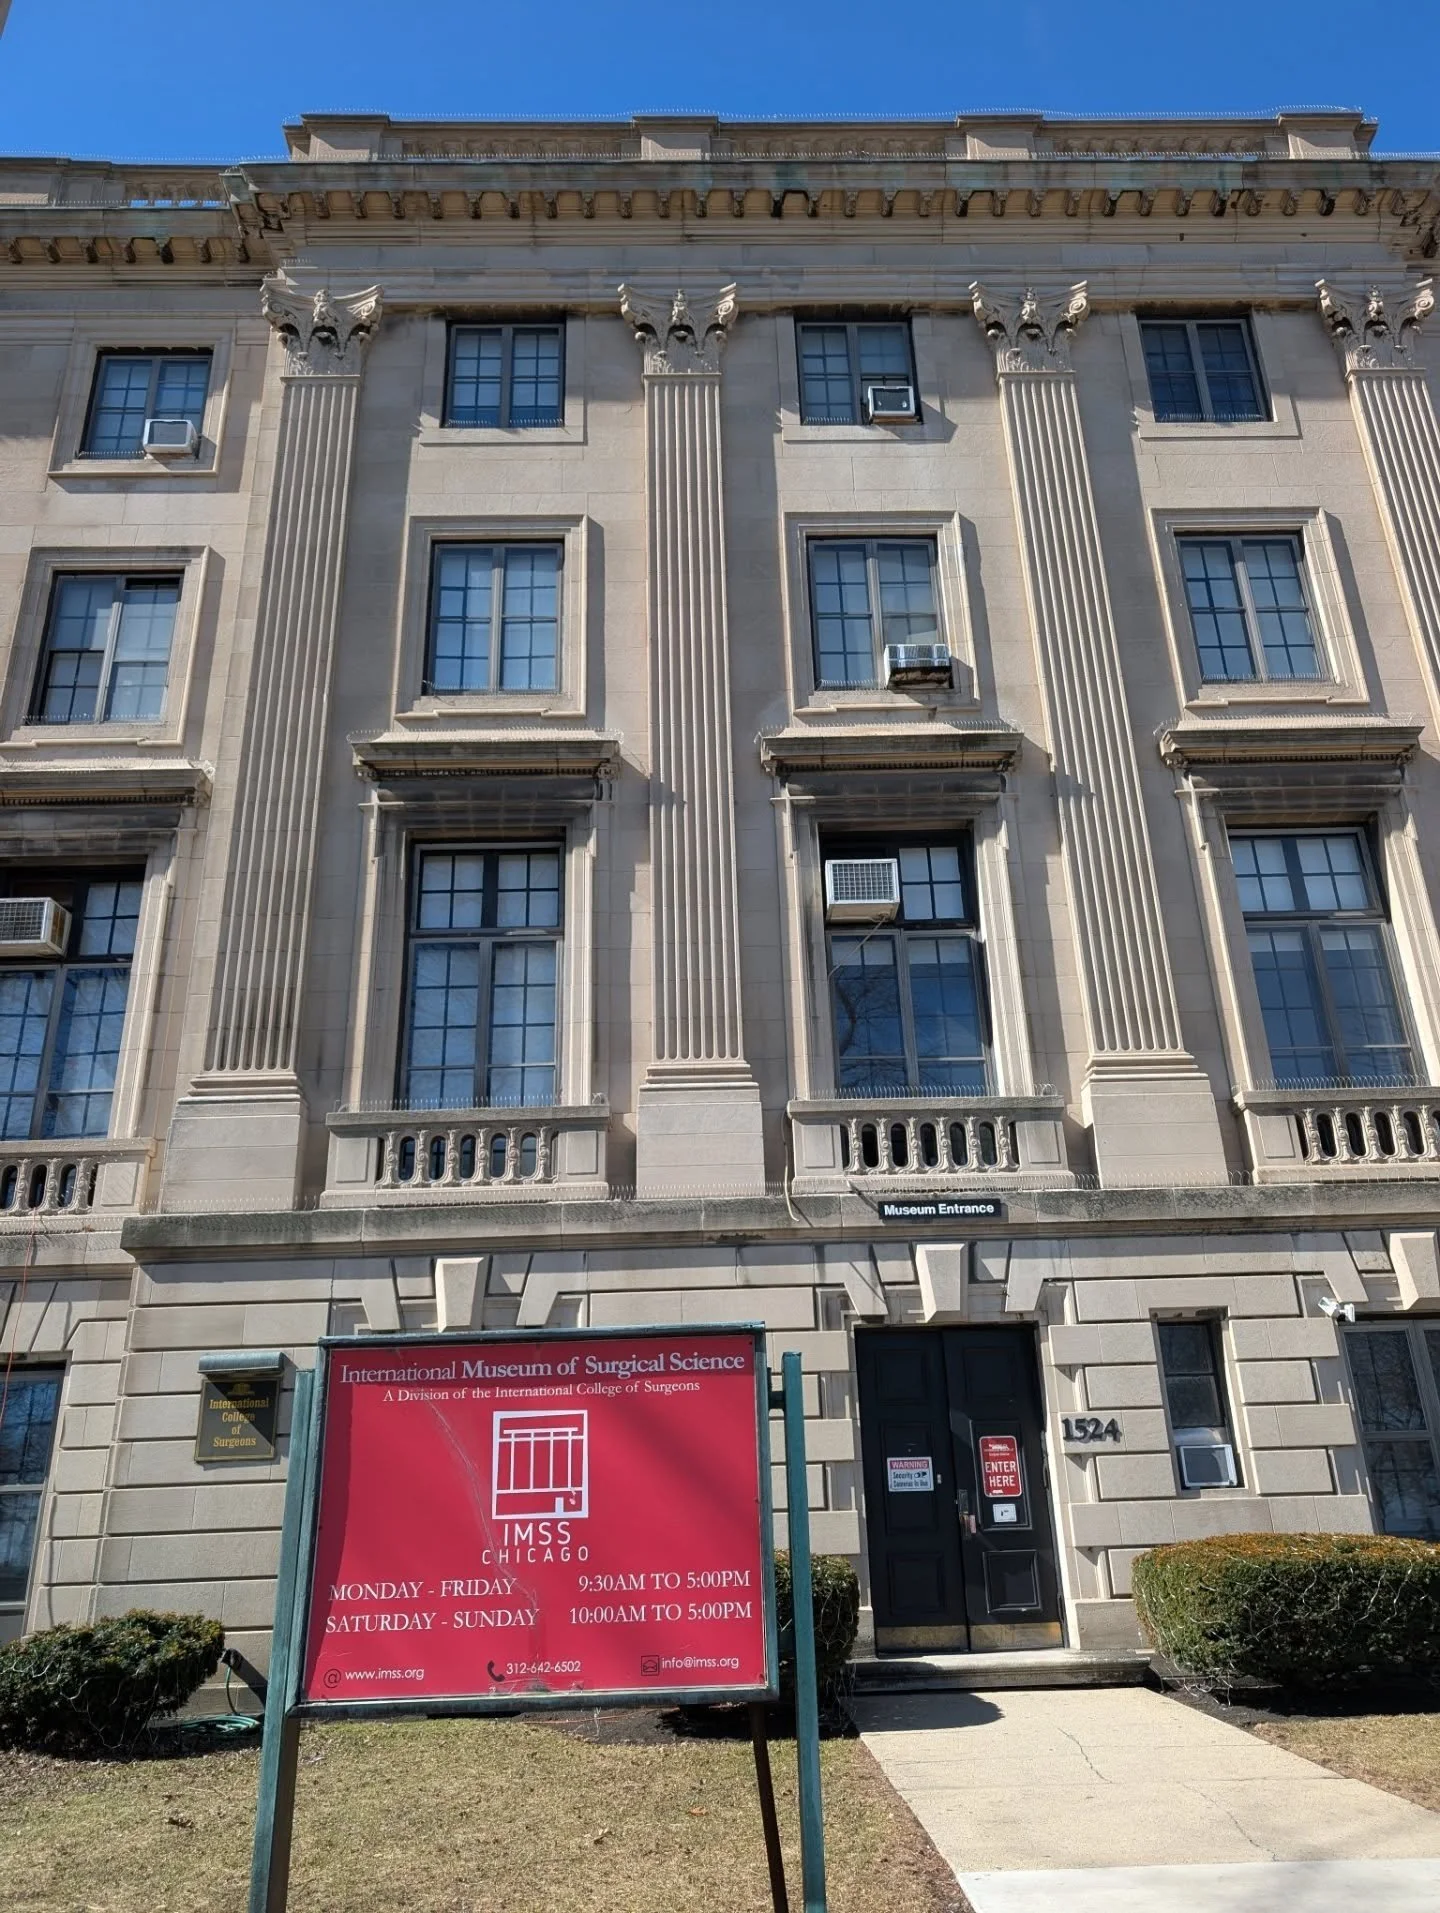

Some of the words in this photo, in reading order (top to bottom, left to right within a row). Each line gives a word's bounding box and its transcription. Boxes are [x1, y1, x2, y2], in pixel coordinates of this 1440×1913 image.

[884, 1204, 936, 1216] Museum
[938, 1203, 994, 1214] Entrance
[340, 1361, 456, 1383] International
[461, 1360, 552, 1379] Museum
[556, 1356, 580, 1376] of
[585, 1353, 665, 1379] Surgical
[669, 1351, 745, 1371] Science
[383, 1391, 393, 1402] A
[398, 1387, 449, 1401] Division
[453, 1387, 468, 1399] of
[472, 1386, 491, 1398] the
[495, 1383, 573, 1398] International
[576, 1382, 622, 1397] College
[625, 1381, 640, 1393] of
[644, 1380, 700, 1395] Surgeons
[210, 1398, 268, 1409] International
[222, 1412, 255, 1423] College
[231, 1425, 241, 1434] of
[1062, 1418, 1121, 1442] 1524
[213, 1437, 256, 1448] Surgeons
[891, 1460, 928, 1469] WARNING
[985, 1461, 1016, 1473] ENTER
[989, 1475, 1016, 1487] HERE
[504, 1521, 571, 1546] IMSS
[482, 1546, 589, 1565] CHICAGO
[578, 1573, 646, 1593] 9:30AM
[650, 1572, 681, 1590] TO
[686, 1570, 752, 1589] 5:00PM
[328, 1581, 424, 1601] MONDAY
[440, 1577, 518, 1597] FRIDAY
[569, 1604, 647, 1625] 10:00AM
[651, 1603, 682, 1622] TO
[687, 1601, 752, 1621] 5:00PM
[325, 1612, 436, 1634] SATURDAY
[453, 1608, 540, 1629] SUNDAY
[506, 1660, 581, 1675] 312-642-6502
[661, 1656, 739, 1669] info@imss.org
[345, 1667, 425, 1681] www.imss.org
